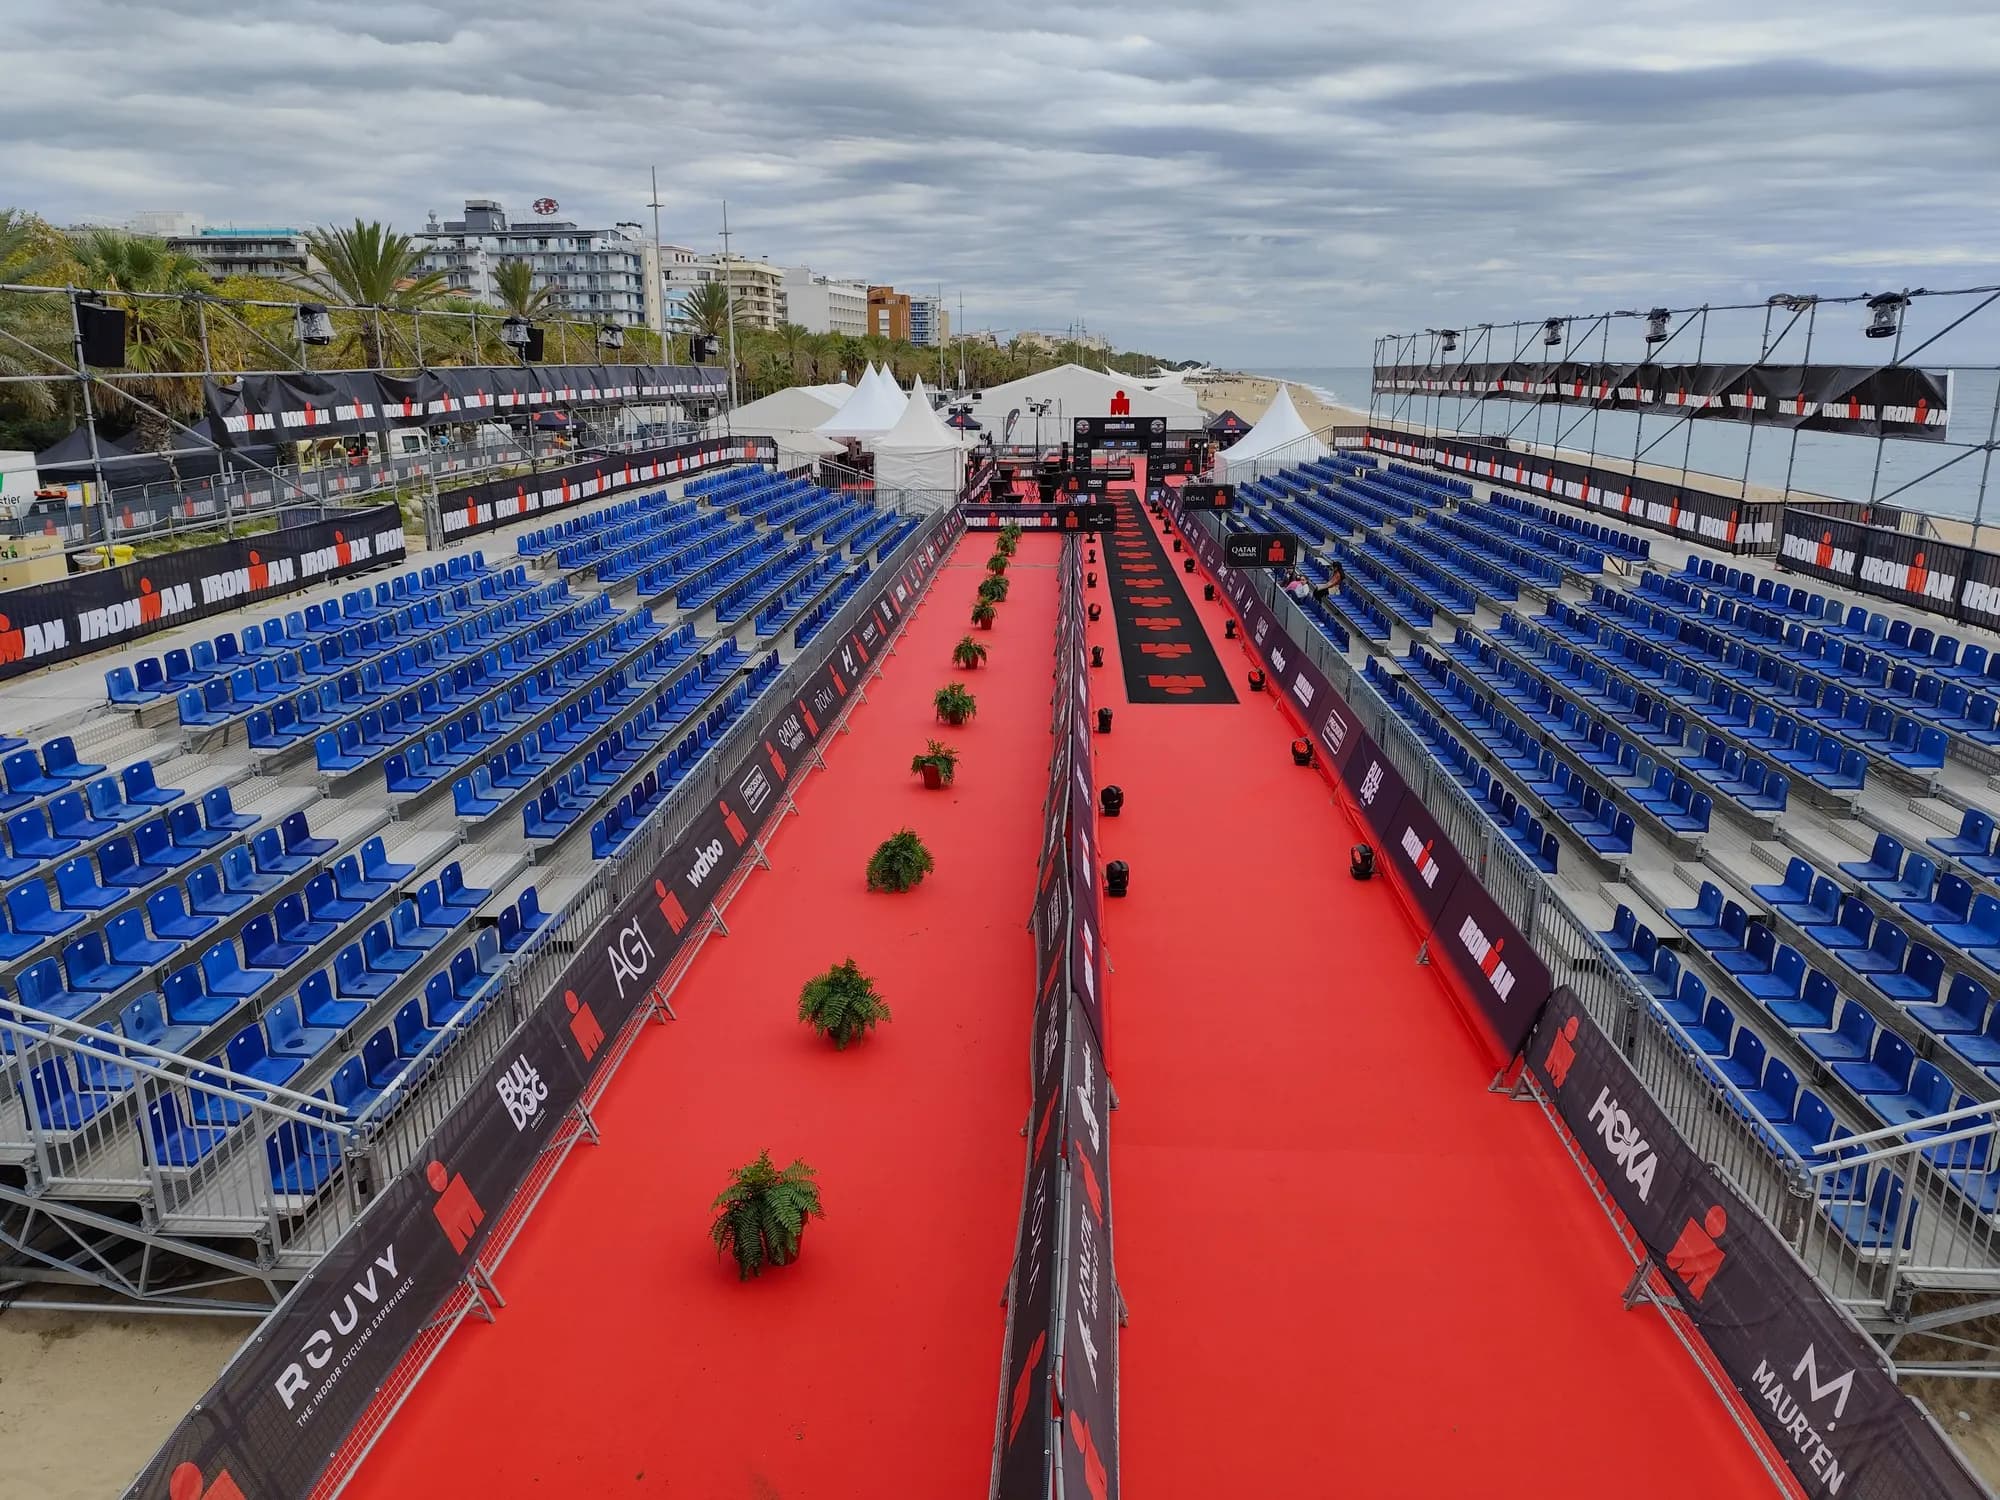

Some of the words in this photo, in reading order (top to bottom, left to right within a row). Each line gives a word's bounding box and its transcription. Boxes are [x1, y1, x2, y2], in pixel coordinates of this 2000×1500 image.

[1232, 546, 1256, 554] QATAR
[686, 837, 724, 889] wahoo
[606, 915, 656, 999] AG1
[496, 1053, 537, 1108] BULL
[508, 1074, 548, 1132] DOG
[1587, 1086, 1659, 1203] HOKA
[274, 1243, 399, 1411] ROUVY
[296, 1404, 314, 1429] THE
[313, 1366, 342, 1407] INDOOR
[341, 1327, 373, 1368] CYCLING
[371, 1276, 415, 1330] EXPERIENCE
[1752, 1359, 1846, 1497] MAURTEN
